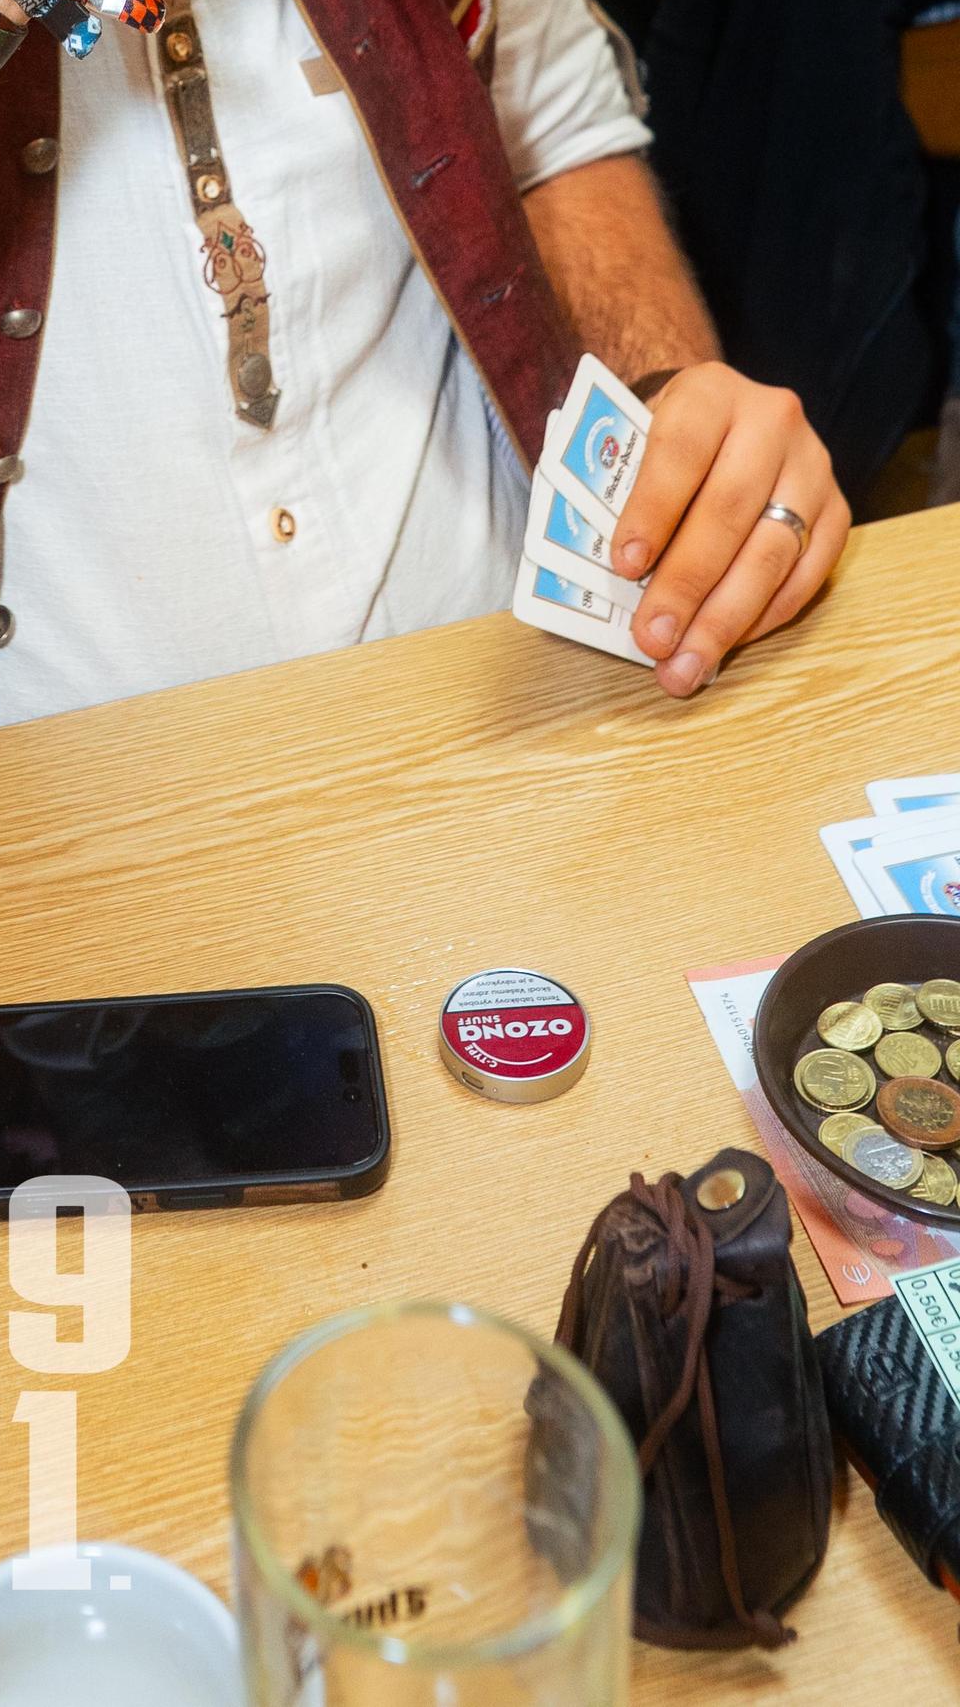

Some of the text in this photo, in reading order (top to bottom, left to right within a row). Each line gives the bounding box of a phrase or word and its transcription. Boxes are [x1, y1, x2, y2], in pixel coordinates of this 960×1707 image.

[457, 1015, 501, 1025] SNUFF
[464, 1044, 498, 1068] C-TYPE
[910, 1278, 948, 1328] 0,50€
